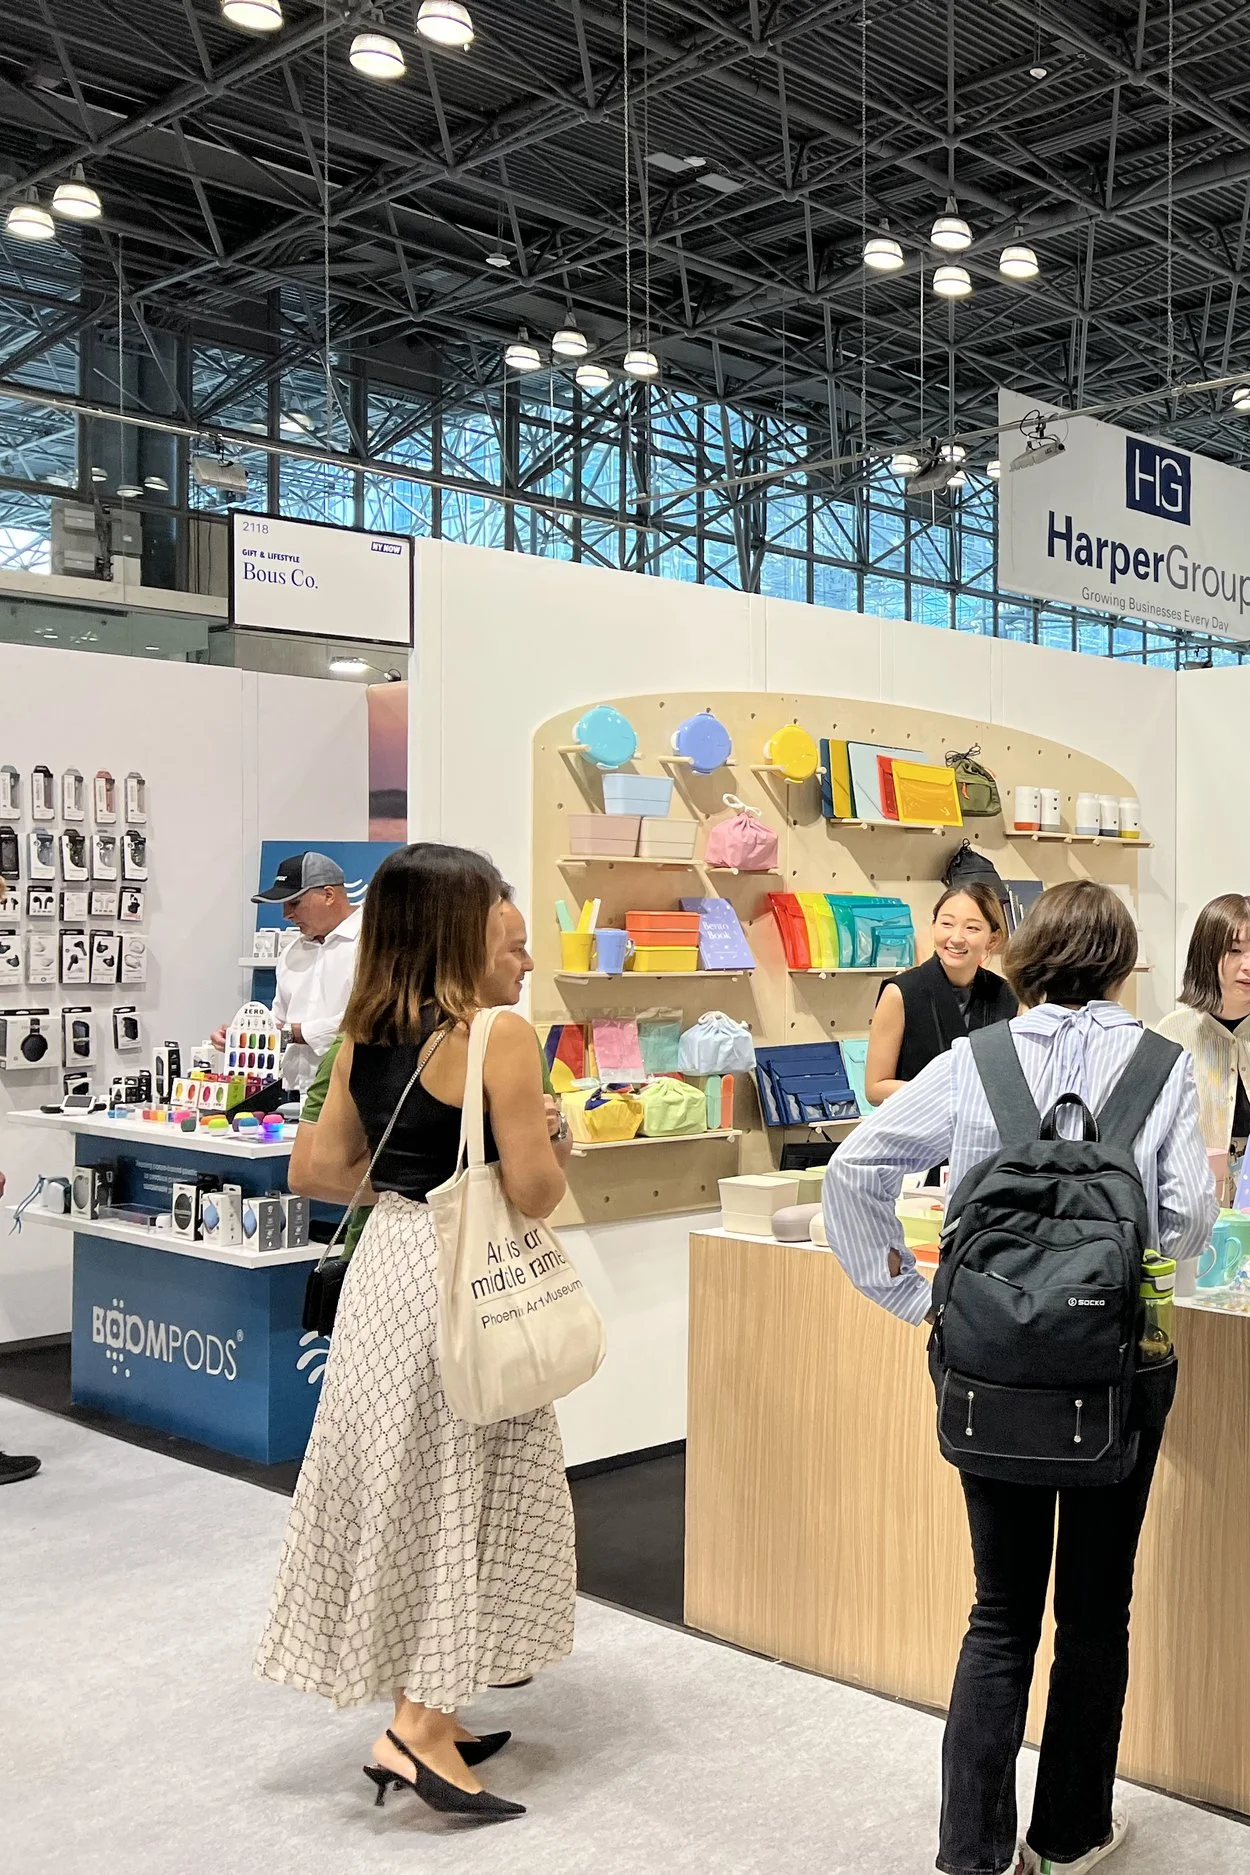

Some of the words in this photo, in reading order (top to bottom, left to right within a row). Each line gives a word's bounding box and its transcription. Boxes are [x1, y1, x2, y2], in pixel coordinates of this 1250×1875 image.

[1135, 448, 1182, 512] HG
[243, 521, 269, 534] 2118
[242, 549, 257, 557] GIFT
[267, 552, 300, 563] LIFESTYLE
[372, 542, 382, 552] NY
[383, 543, 401, 554] NOW
[243, 562, 286, 585] Bous
[291, 569, 319, 589] Co.
[1082, 586, 1126, 610] Growing
[1129, 597, 1181, 621] Businesses
[1184, 610, 1210, 629] Every
[1212, 616, 1229, 632] Day
[505, 1237, 520, 1259] is
